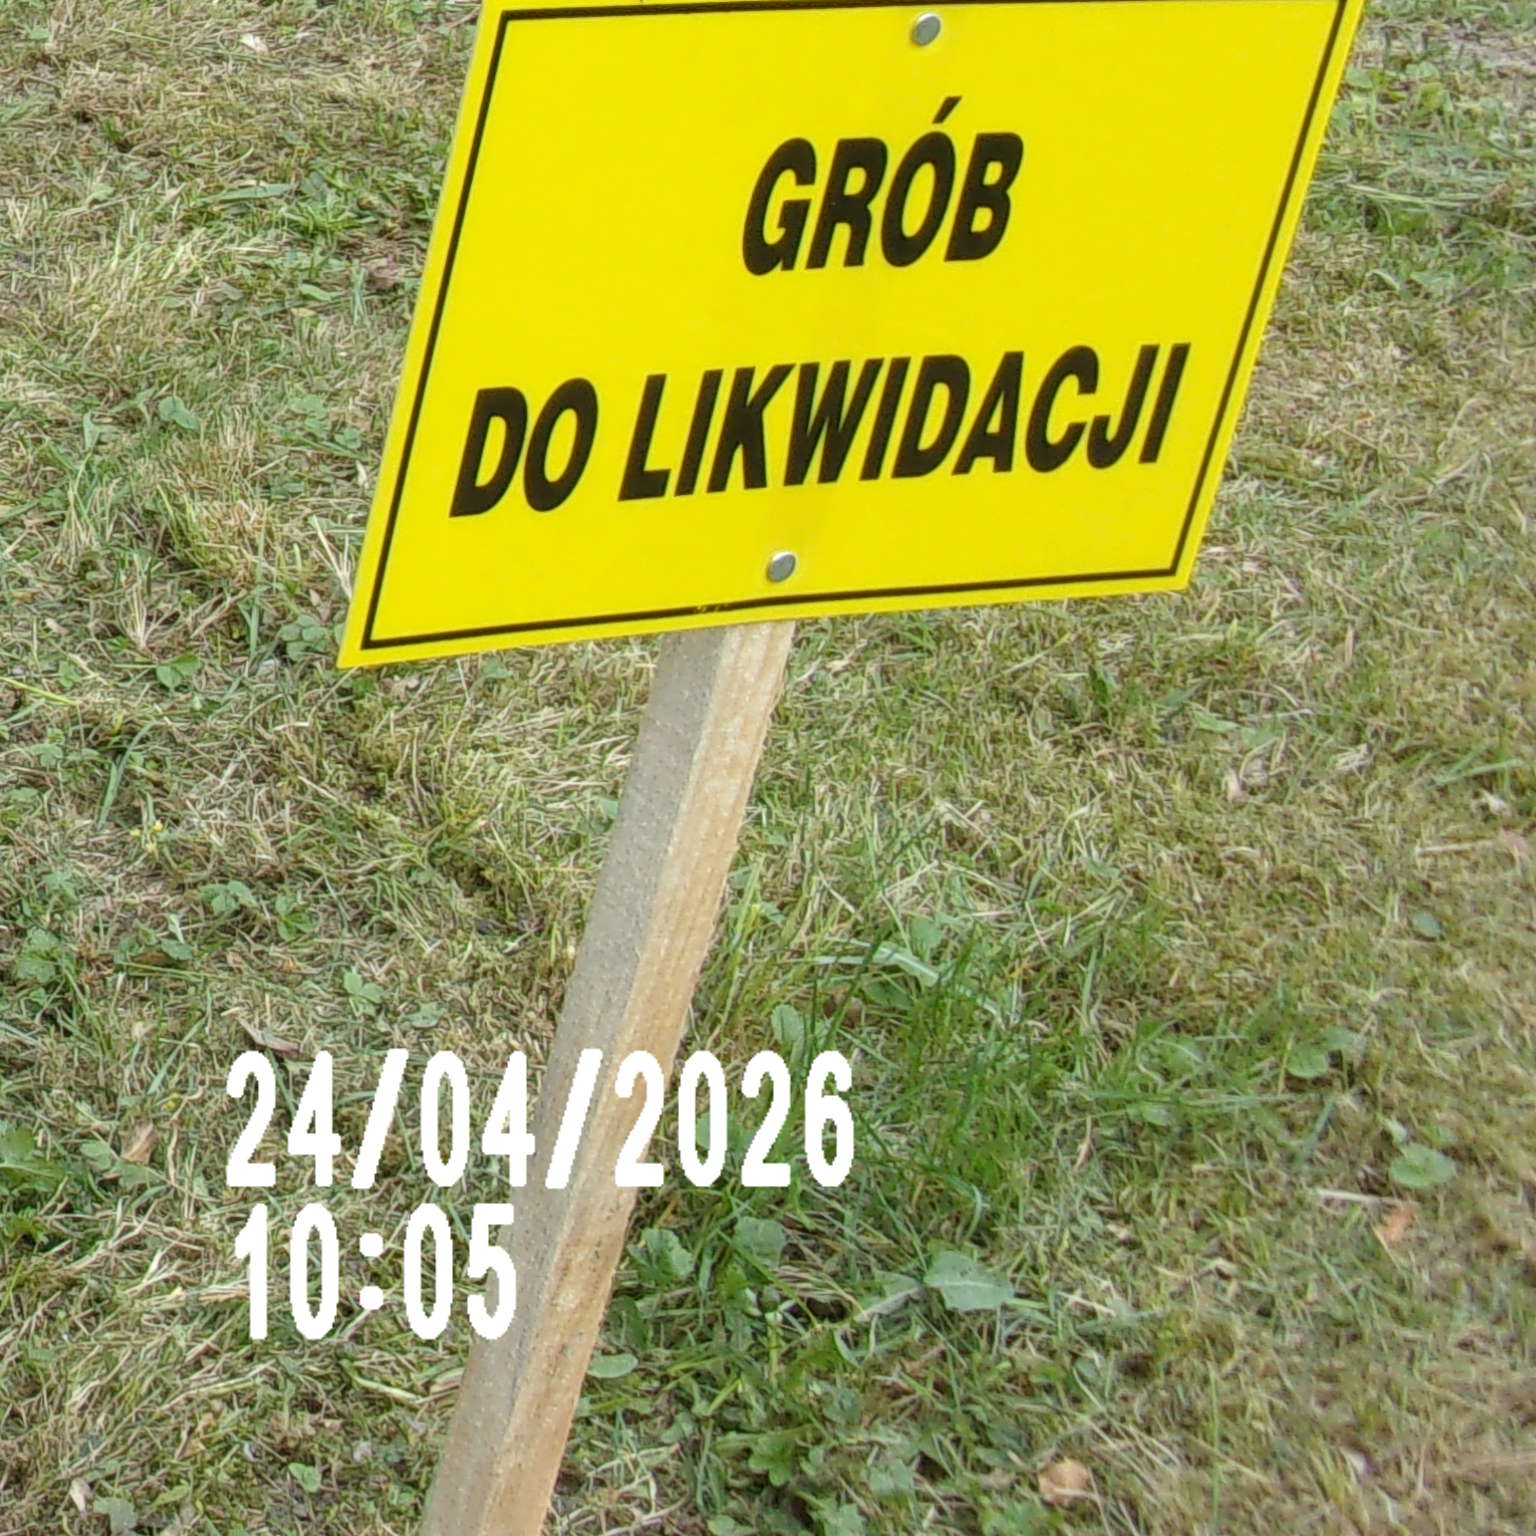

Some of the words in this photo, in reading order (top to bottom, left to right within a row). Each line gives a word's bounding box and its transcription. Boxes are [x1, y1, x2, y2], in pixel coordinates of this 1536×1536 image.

[741, 95, 1025, 277] GRÓB
[448, 377, 599, 519] DO
[617, 342, 1191, 502] LIKWIDACJI
